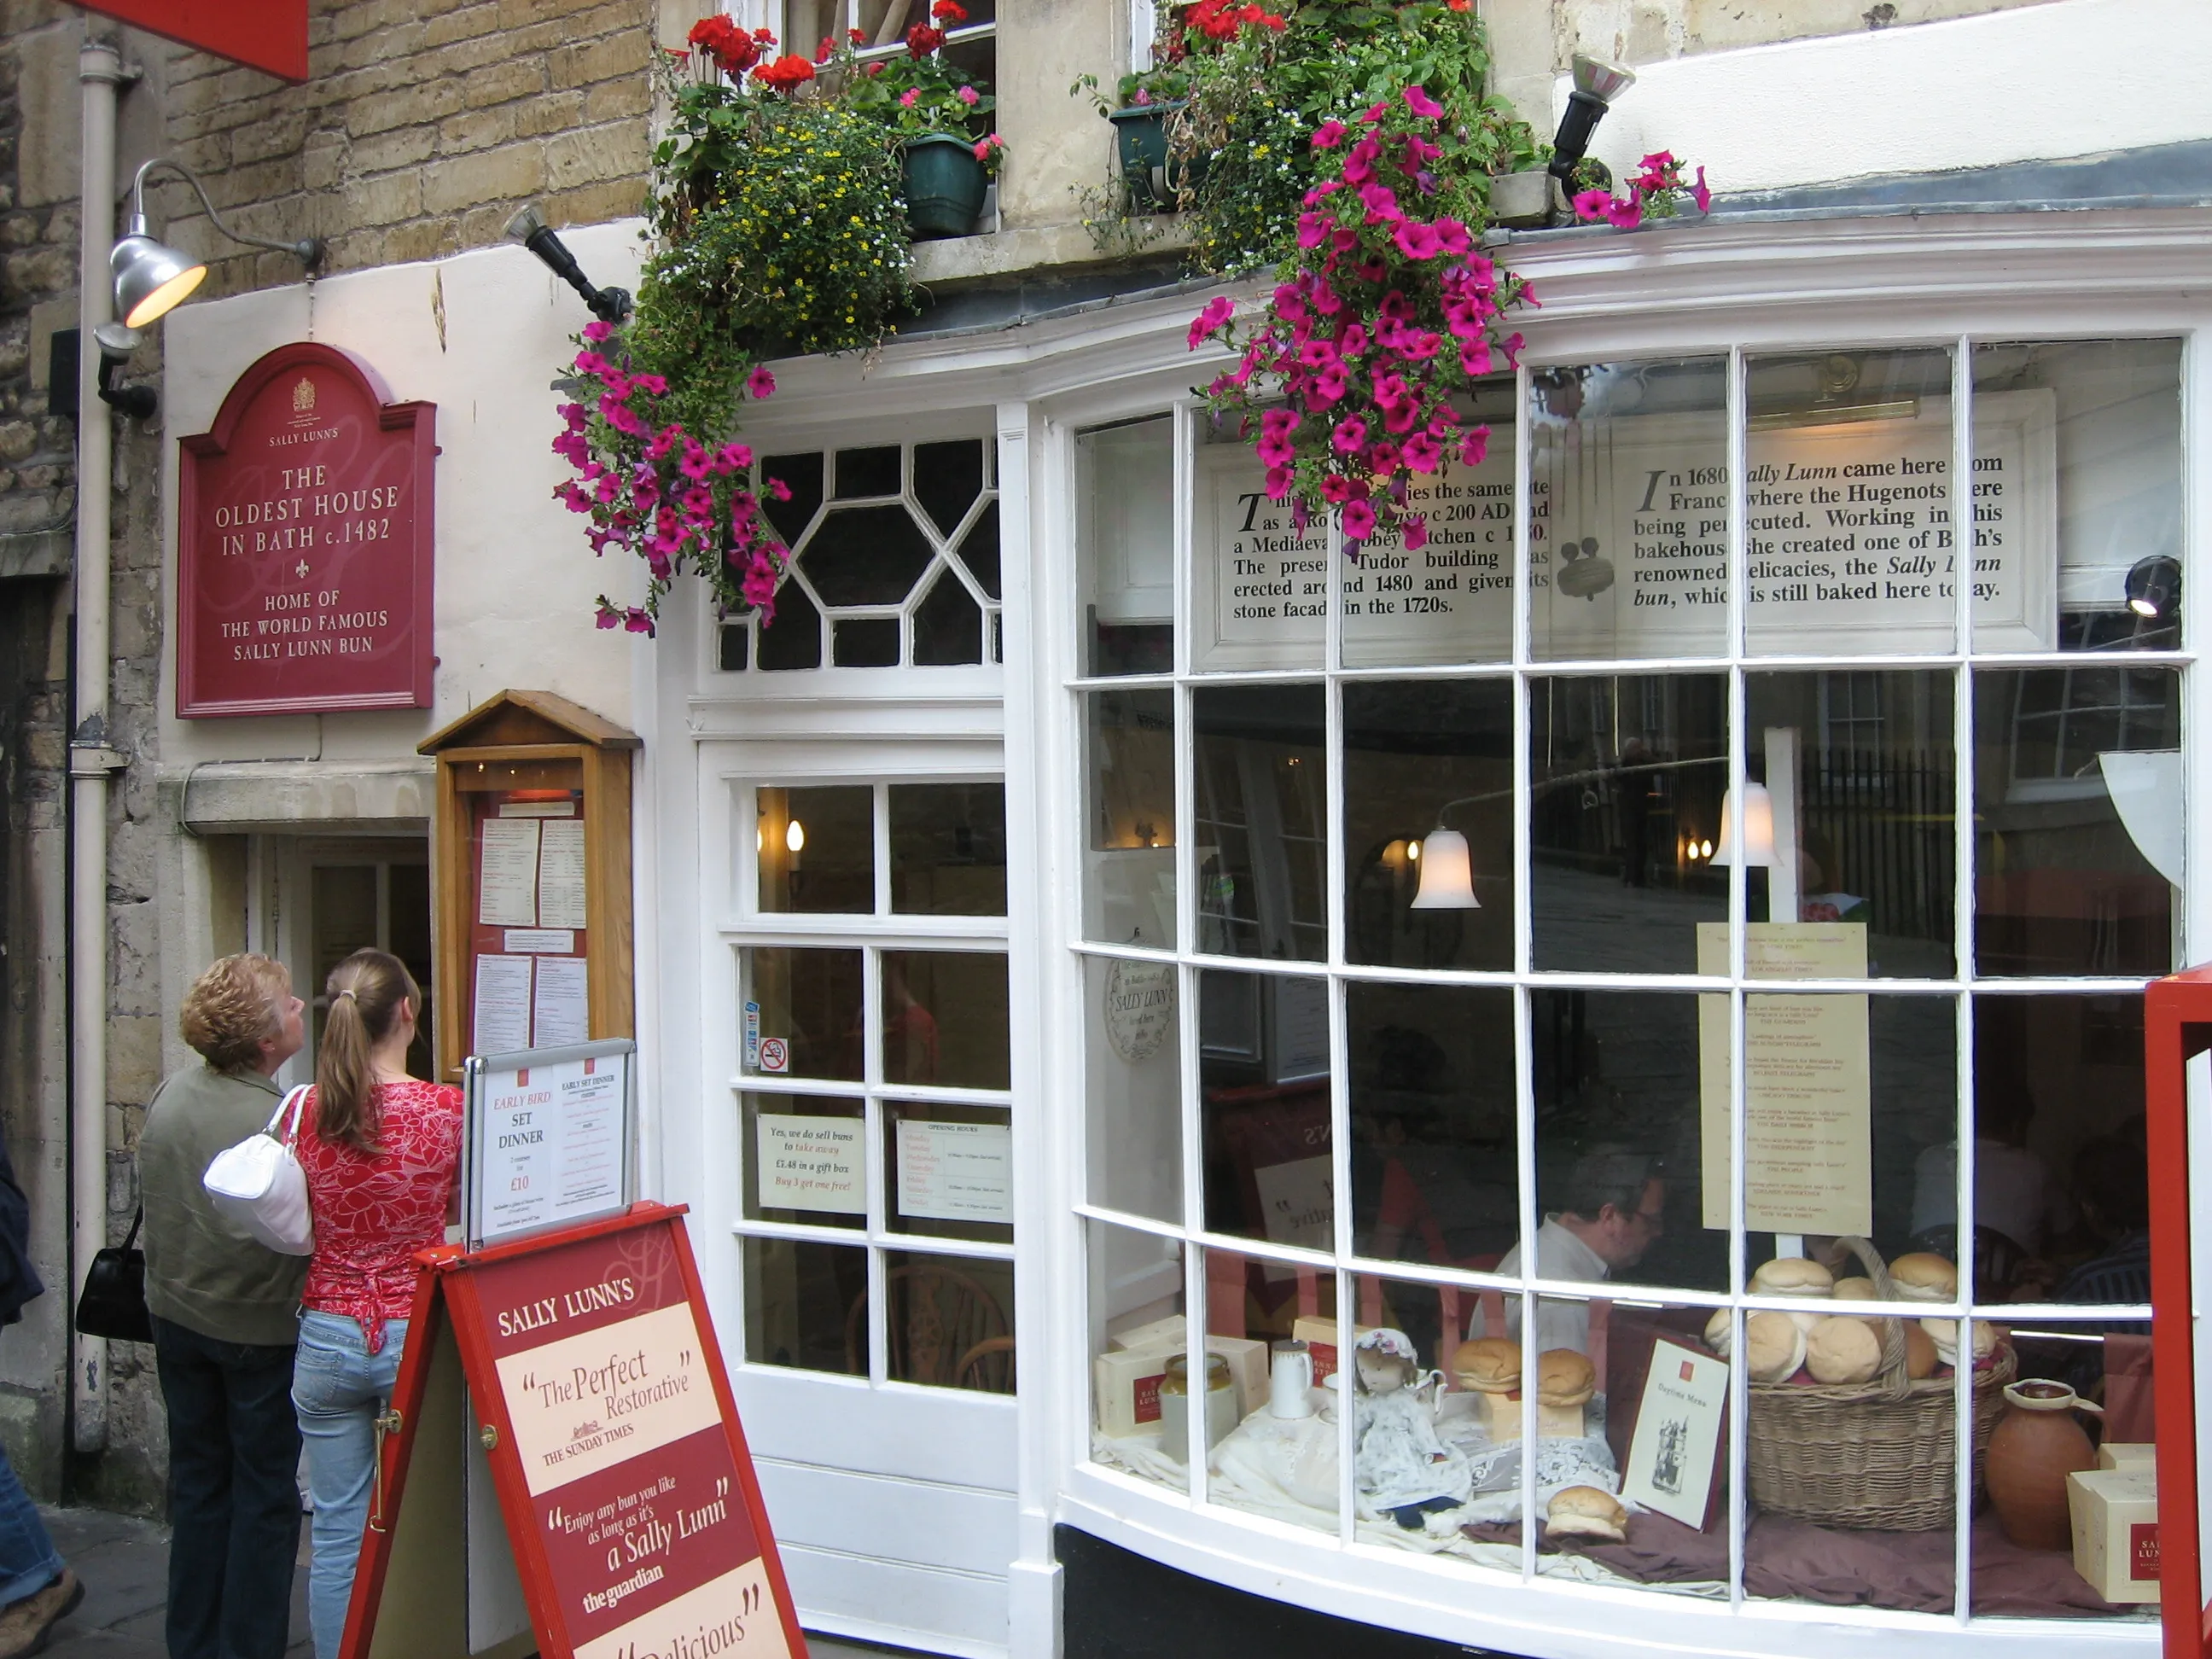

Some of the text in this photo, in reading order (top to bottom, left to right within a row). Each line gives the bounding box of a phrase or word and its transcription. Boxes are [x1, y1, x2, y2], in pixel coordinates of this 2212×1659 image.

[268, 433, 299, 447] SALLY
[282, 465, 326, 490] THE
[1747, 464, 1780, 486] ally
[1784, 463, 1837, 481] Lunn
[1842, 463, 1895, 478] came
[1901, 457, 1947, 474] here
[1435, 482, 1462, 499] the
[1467, 483, 1513, 498] same
[1669, 482, 2003, 510] Franc where the Hugenots ere
[215, 486, 399, 527] OLDEST HOUSE
[1262, 517, 1279, 531] as
[1432, 509, 1441, 521] c
[1446, 504, 1476, 521] 200
[1481, 502, 1510, 521] AD
[1633, 517, 1685, 538] being
[1825, 507, 1915, 529] Working
[1929, 506, 1950, 523] in
[1972, 503, 2003, 522] his
[222, 533, 245, 556] IN
[256, 526, 314, 552] BATH
[1234, 542, 1243, 554] a
[1252, 535, 1328, 553] Mediaeva
[1427, 527, 1476, 545] tchen
[1485, 530, 1493, 543] c
[1633, 540, 1727, 559] bakehous
[1782, 533, 1855, 554] created
[1864, 535, 1901, 550] one
[1908, 530, 1930, 550] of
[1937, 528, 2002, 549] Bh's
[1234, 559, 1266, 575] The
[1280, 560, 1328, 578] prese
[1358, 553, 1409, 571] Tudor
[1426, 549, 1499, 570] building
[1633, 555, 2001, 583] renowned elicacies, the Sally Lnn
[1234, 579, 1292, 597] erected
[1303, 576, 1364, 595] arond
[1376, 574, 1413, 592] 1480
[1424, 573, 1458, 591] and
[1469, 573, 1514, 594] given
[1633, 580, 2000, 609] bun, whic is still baked here toay.
[265, 590, 340, 611] HOME OF
[1233, 596, 1453, 619] stone facad in the 1720s.
[222, 610, 387, 637] THE WORLD FAMOUS
[234, 636, 374, 661] SALLY LUNN BUN
[1115, 992, 1144, 1012] SALLY
[562, 1080, 580, 1091] EARLY
[581, 1078, 591, 1087] SET
[494, 1091, 551, 1110] EARLY BIRD
[512, 1112, 533, 1127] SET
[498, 1129, 544, 1149] DINNER
[771, 1127, 786, 1138] Yes,
[802, 1129, 813, 1139] do
[815, 1130, 830, 1140] sell
[832, 1132, 853, 1141] buns
[784, 1143, 794, 1151] to
[799, 1161, 807, 1170] in
[815, 1162, 832, 1174] gift
[833, 1162, 849, 1173] box
[510, 1175, 529, 1191] £10
[498, 1278, 635, 1337] SALLY LUNN'S
[572, 1349, 649, 1401] Perfect
[542, 1423, 635, 1467] THE SUNDAY TIMES
[597, 1502, 616, 1521] any
[617, 1493, 638, 1511] bun
[638, 1487, 658, 1505] you
[658, 1476, 677, 1494] like
[587, 1505, 655, 1545] as long as it's
[607, 1546, 621, 1571] a
[624, 1519, 672, 1563] Sally
